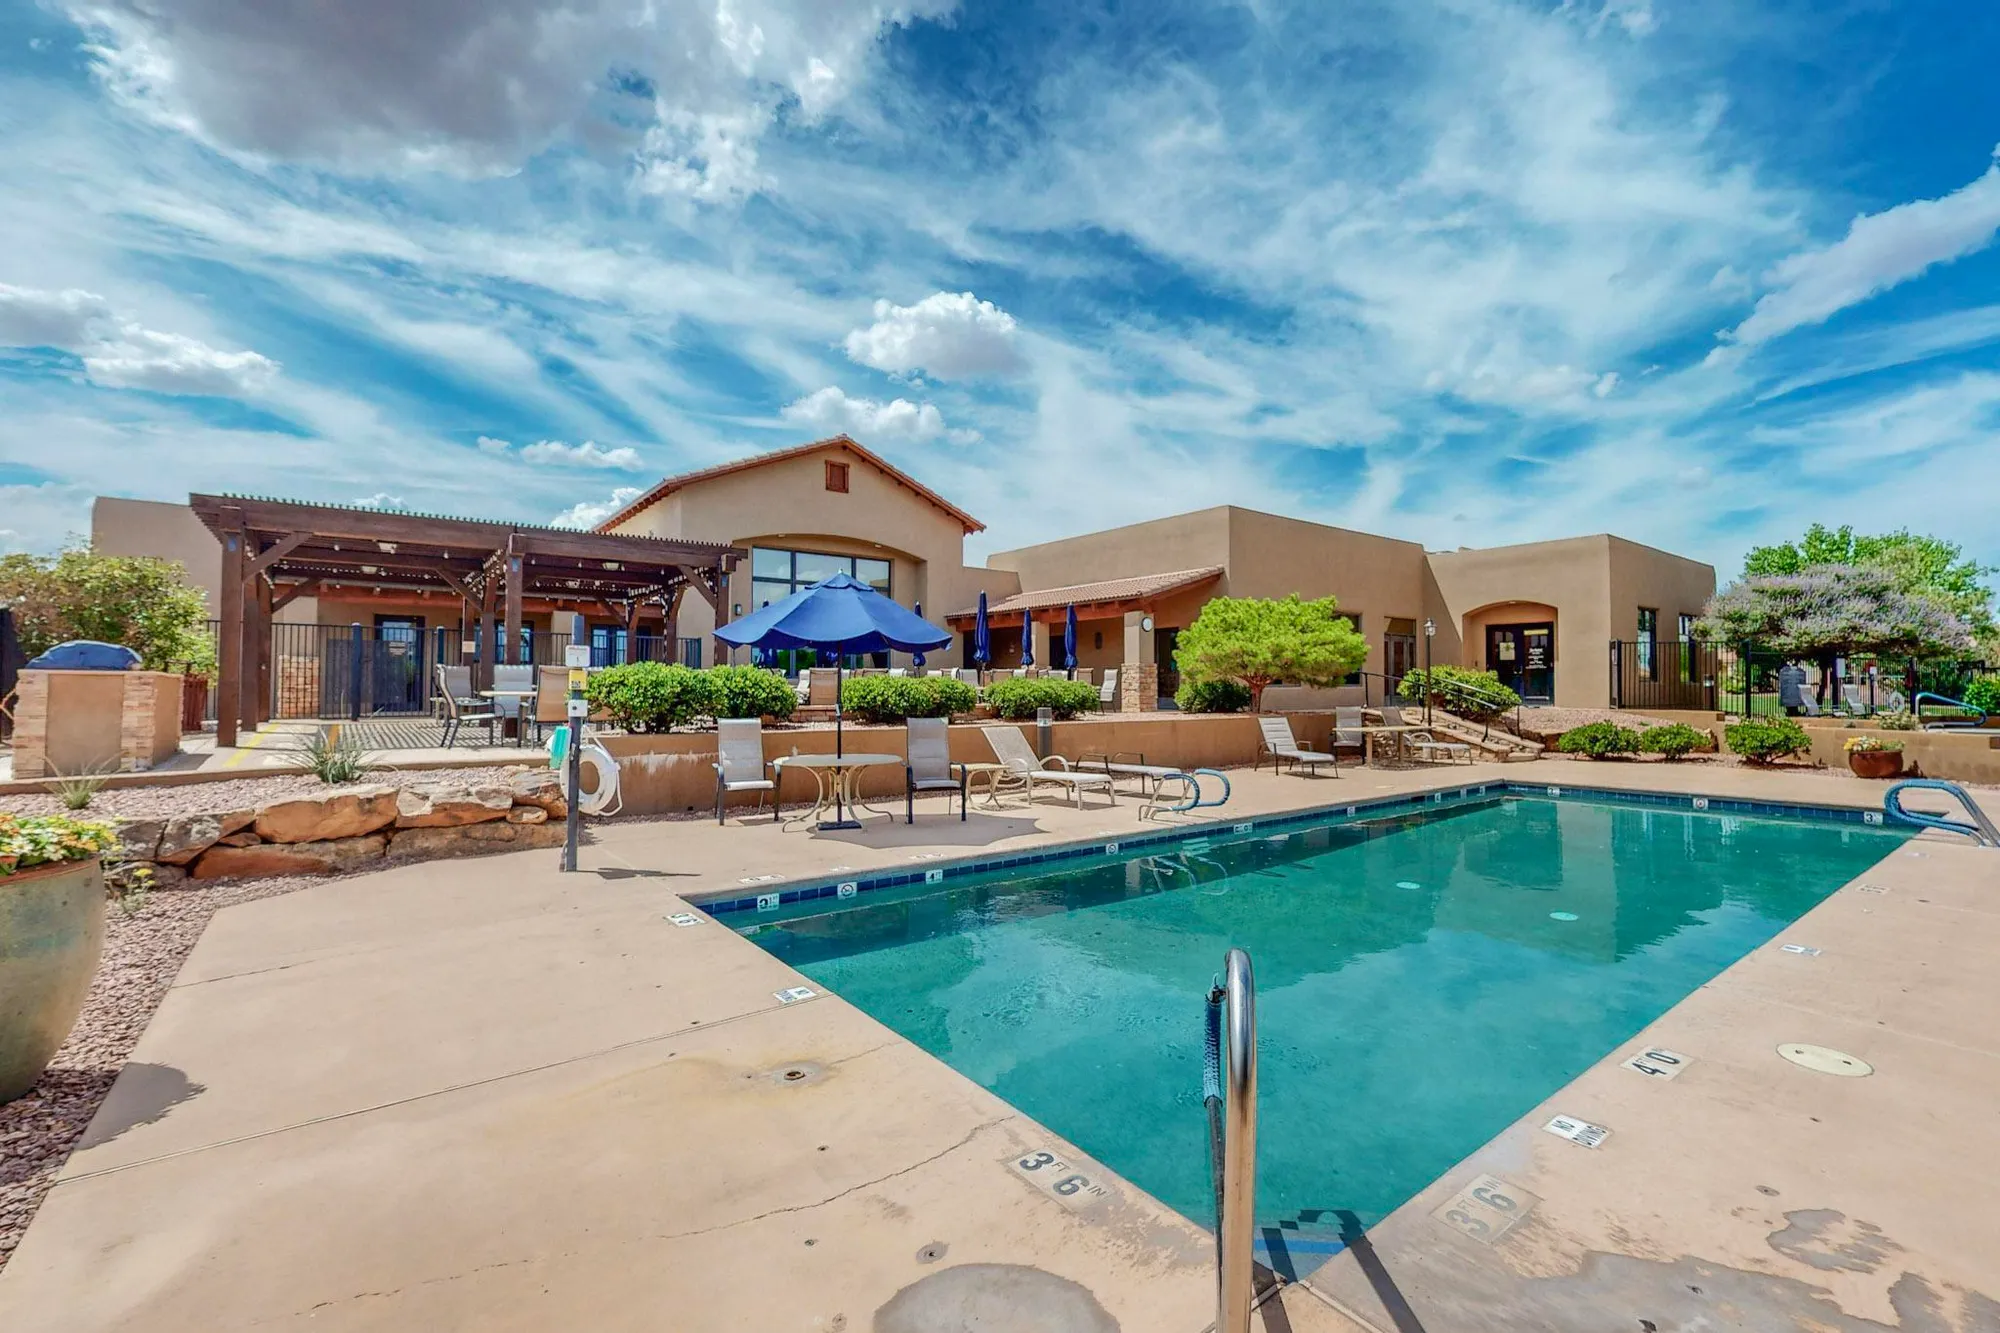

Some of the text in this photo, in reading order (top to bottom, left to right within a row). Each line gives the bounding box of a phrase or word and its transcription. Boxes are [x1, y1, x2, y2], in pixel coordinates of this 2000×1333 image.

[1866, 813, 1873, 823] 3
[1644, 1051, 1681, 1065] 0
[1632, 1062, 1668, 1076] 4
[1551, 1119, 1575, 1133] NO
[1572, 1125, 1607, 1146] DIVING
[1019, 1152, 1107, 1197] 3 FT 6 IN
[1445, 1209, 1490, 1235] 3
[1472, 1187, 1518, 1212] 6
